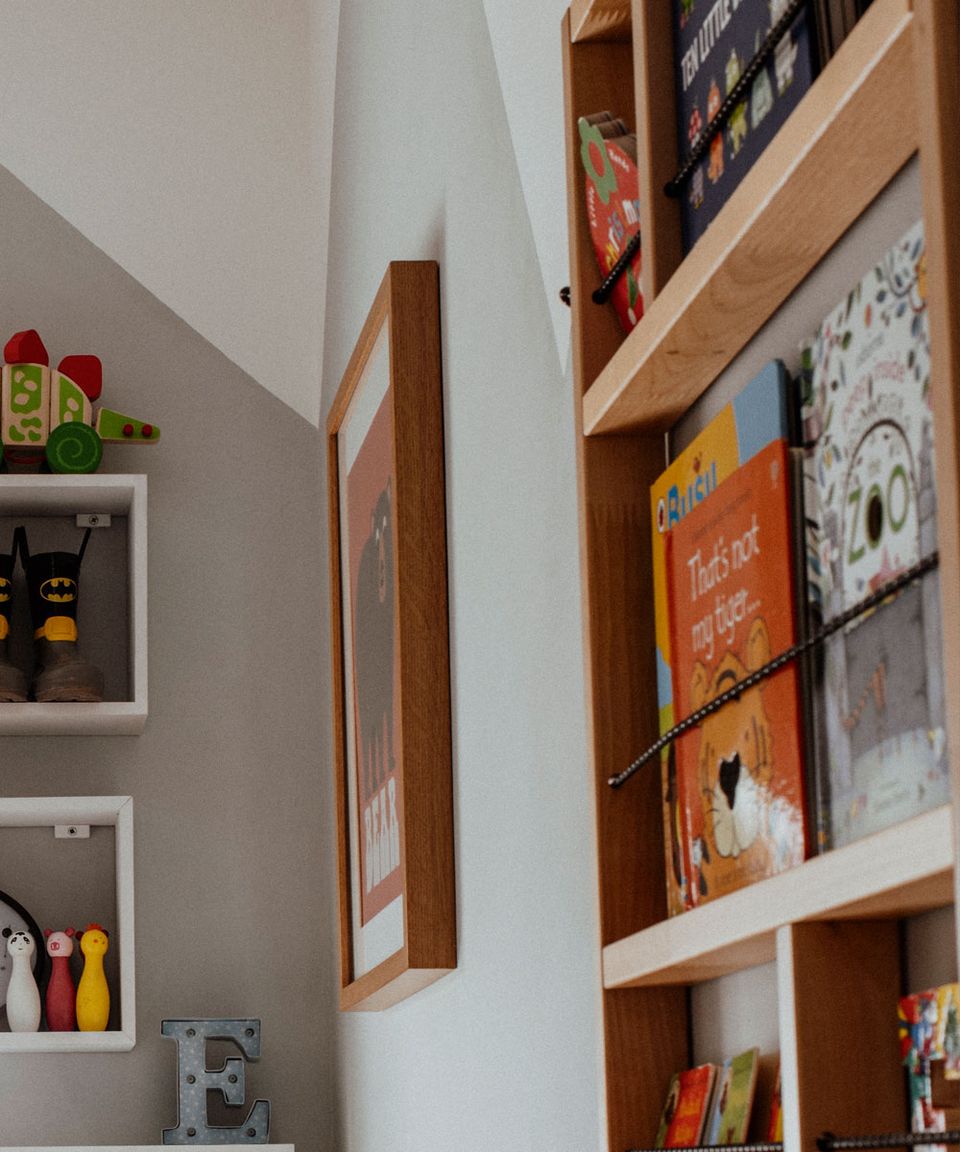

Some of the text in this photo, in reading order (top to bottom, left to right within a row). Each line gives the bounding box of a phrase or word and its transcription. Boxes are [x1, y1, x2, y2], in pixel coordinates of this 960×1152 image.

[681, 36, 699, 91] TEN
[688, 535, 730, 602] That's
[732, 512, 760, 571] not
[848, 463, 910, 566] ZOO
[691, 614, 716, 661] my
[364, 776, 401, 897] BEAR
[161, 1017, 271, 1145] E
